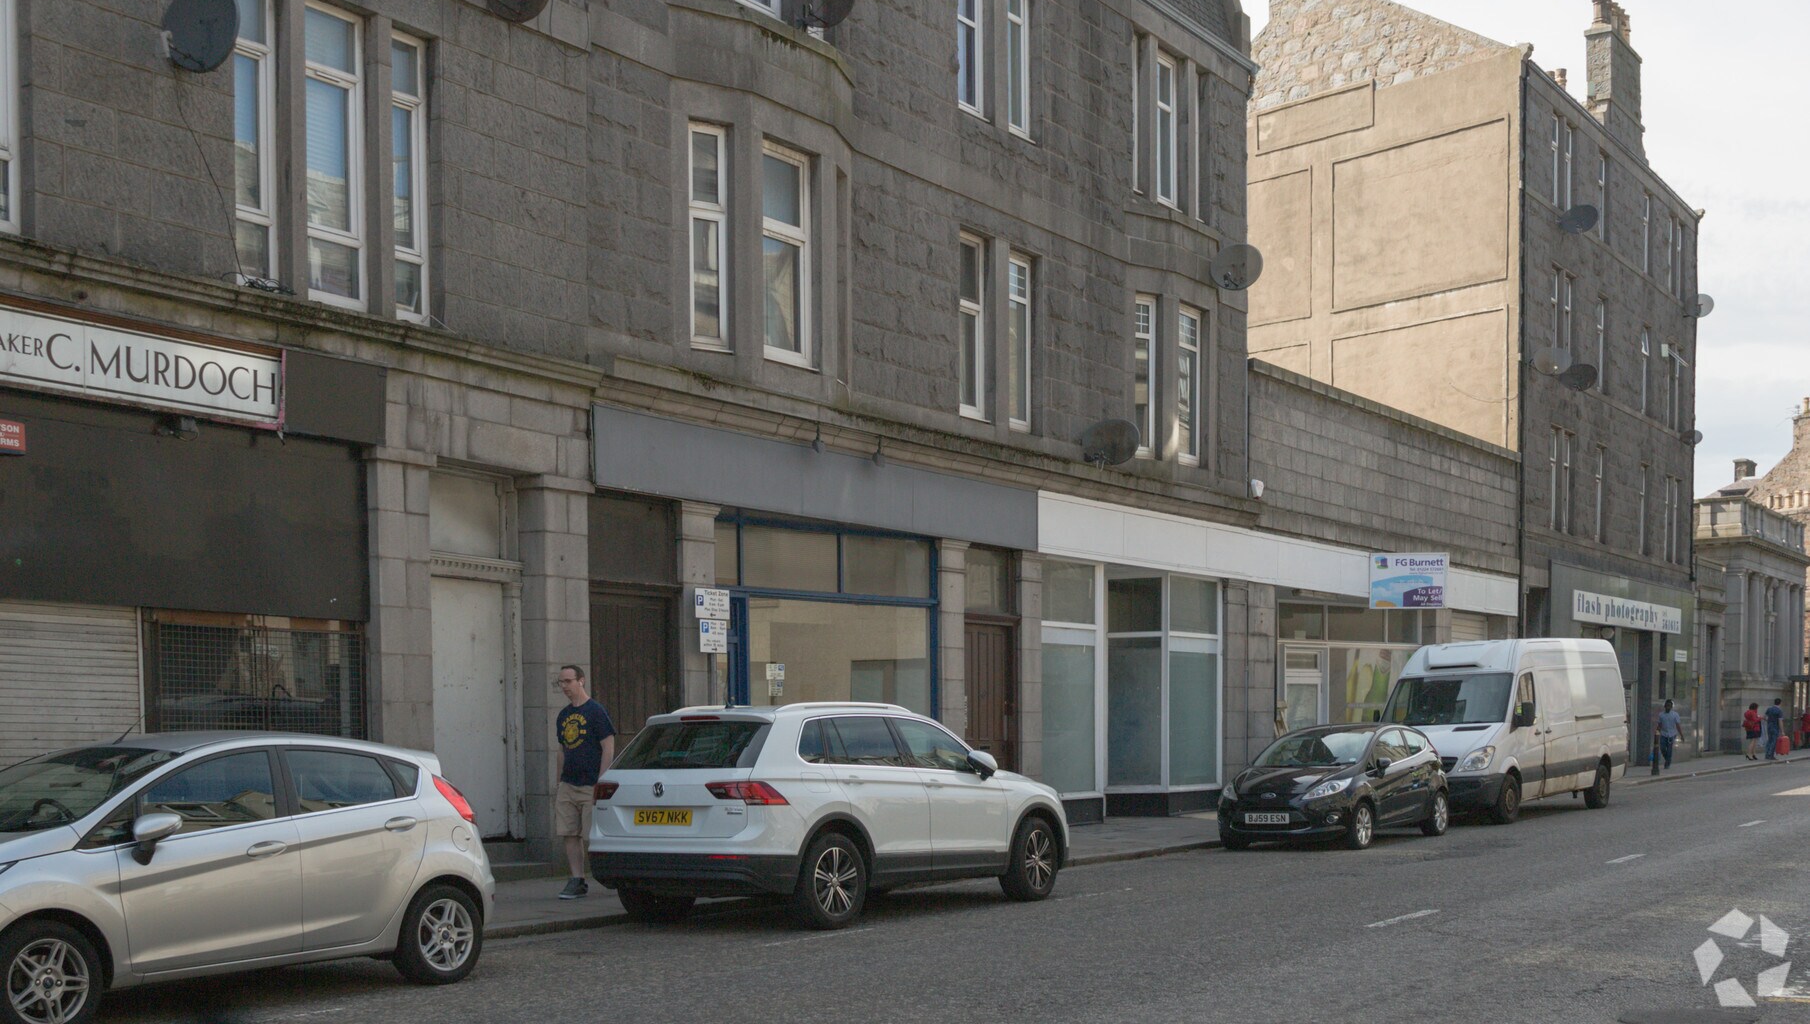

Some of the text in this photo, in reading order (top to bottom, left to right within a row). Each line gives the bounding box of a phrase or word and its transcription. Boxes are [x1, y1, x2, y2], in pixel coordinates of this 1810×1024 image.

[46, 333, 81, 372] C.
[90, 339, 276, 405] MURDOCH
[1395, 558, 1444, 567] FG Burnett
[704, 589, 718, 597] Ticket
[1577, 592, 1658, 629] flash photography
[638, 811, 688, 824] SV67 NKK
[1248, 814, 1286, 823] BJ59 ESN
